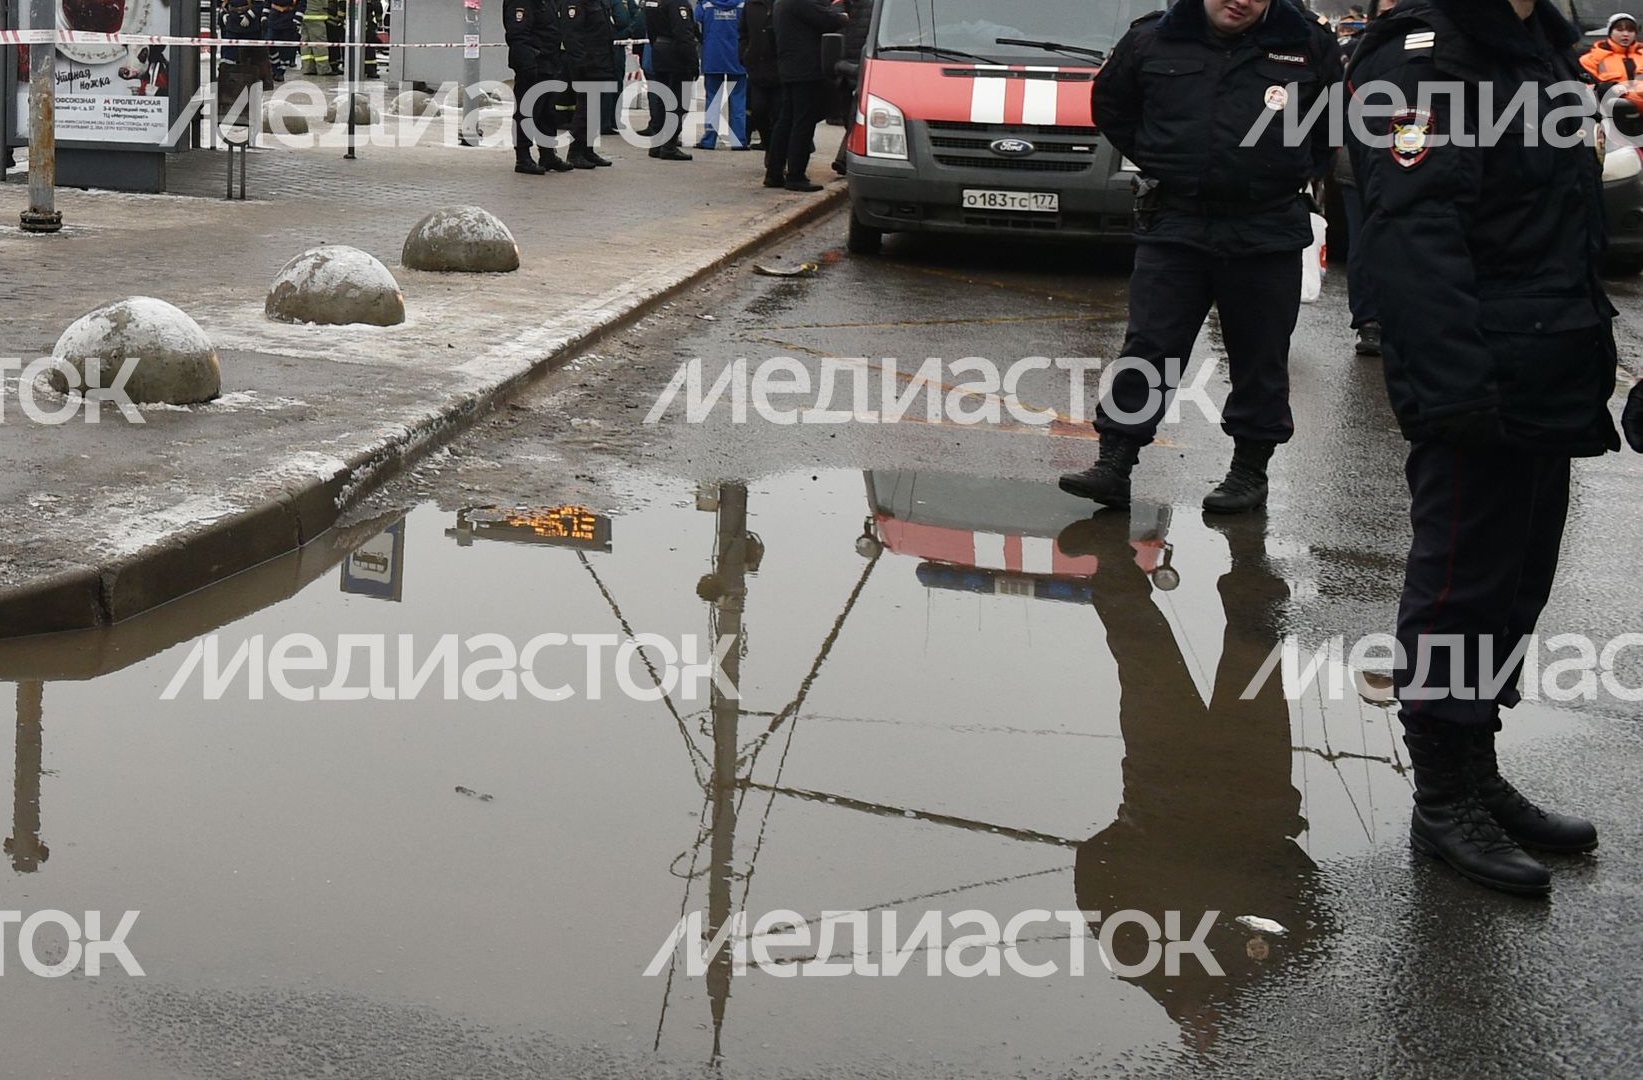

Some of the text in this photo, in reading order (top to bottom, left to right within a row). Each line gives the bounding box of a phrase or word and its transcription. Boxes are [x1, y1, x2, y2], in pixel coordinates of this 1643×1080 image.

[112, 98, 161, 106] ПРОЛЕТАРСКАЯ
[999, 141, 1024, 152] Ford
[1032, 194, 1054, 206] 177
